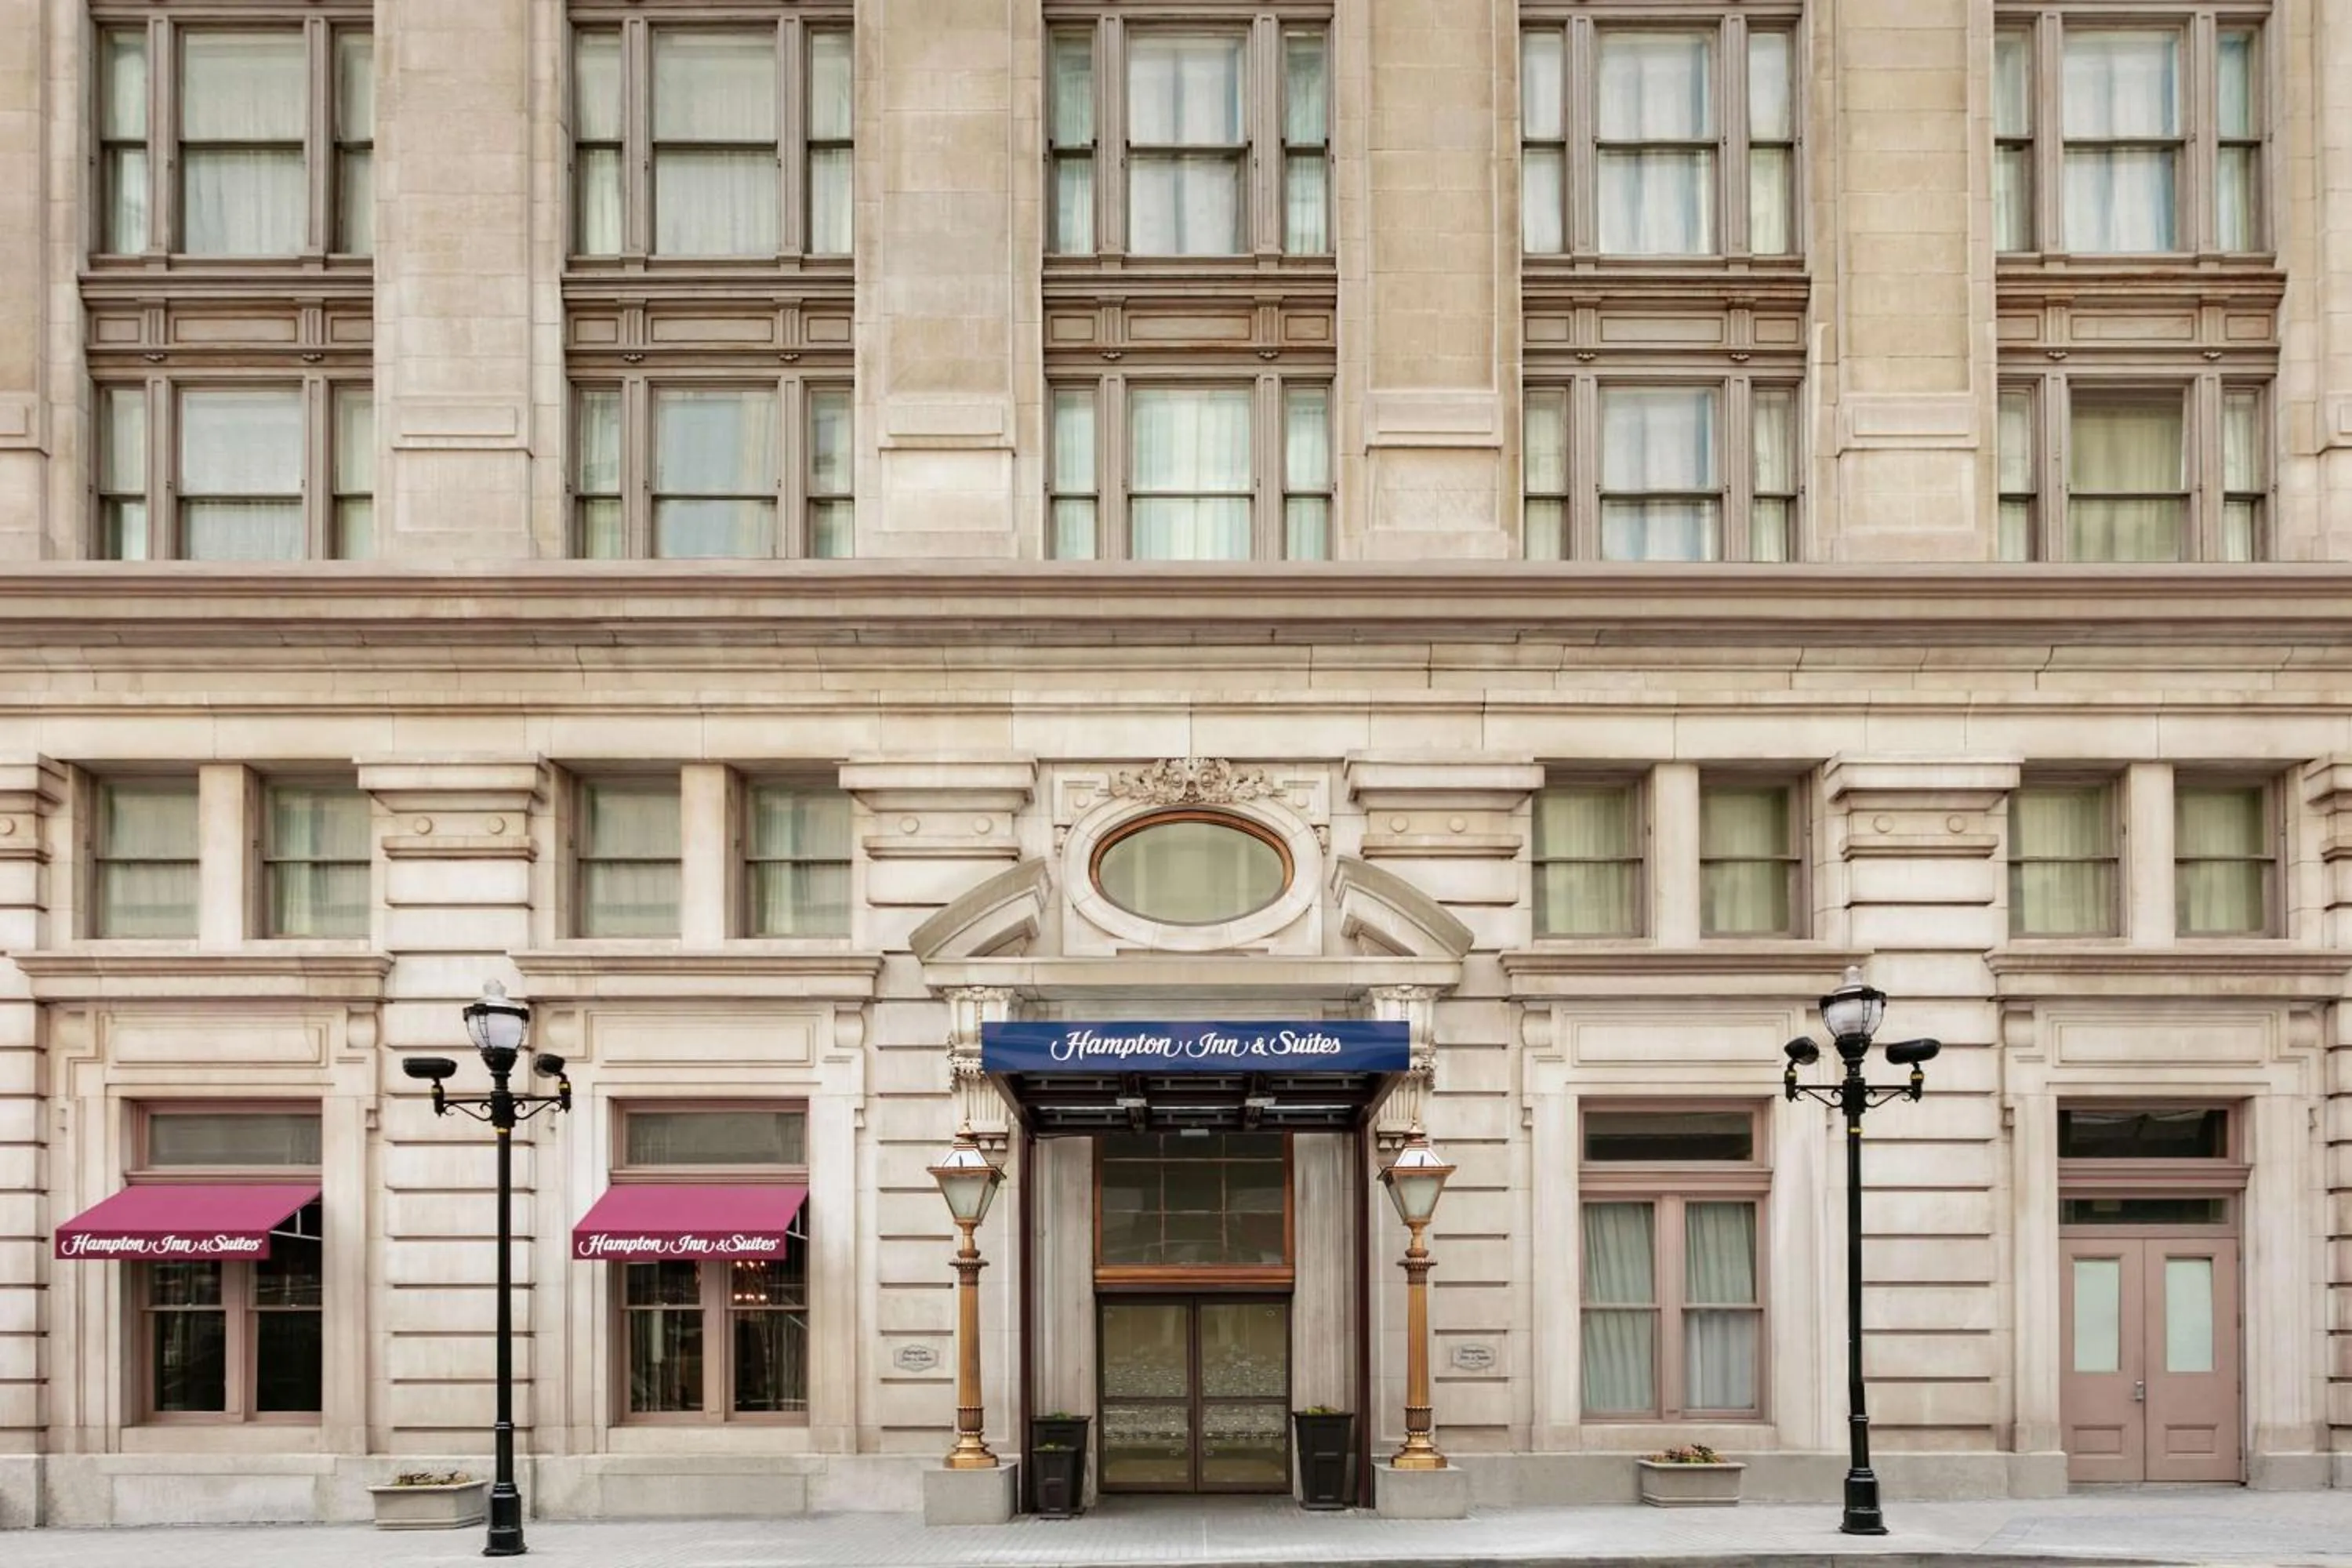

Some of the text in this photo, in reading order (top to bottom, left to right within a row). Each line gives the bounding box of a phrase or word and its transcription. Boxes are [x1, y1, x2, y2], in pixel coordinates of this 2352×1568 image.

[1051, 1029, 1341, 1060] Hampton Inn & Suites
[61, 1234, 259, 1254] Hampton Inn & Suites
[579, 1234, 776, 1254] Hampton Inn & Suites
